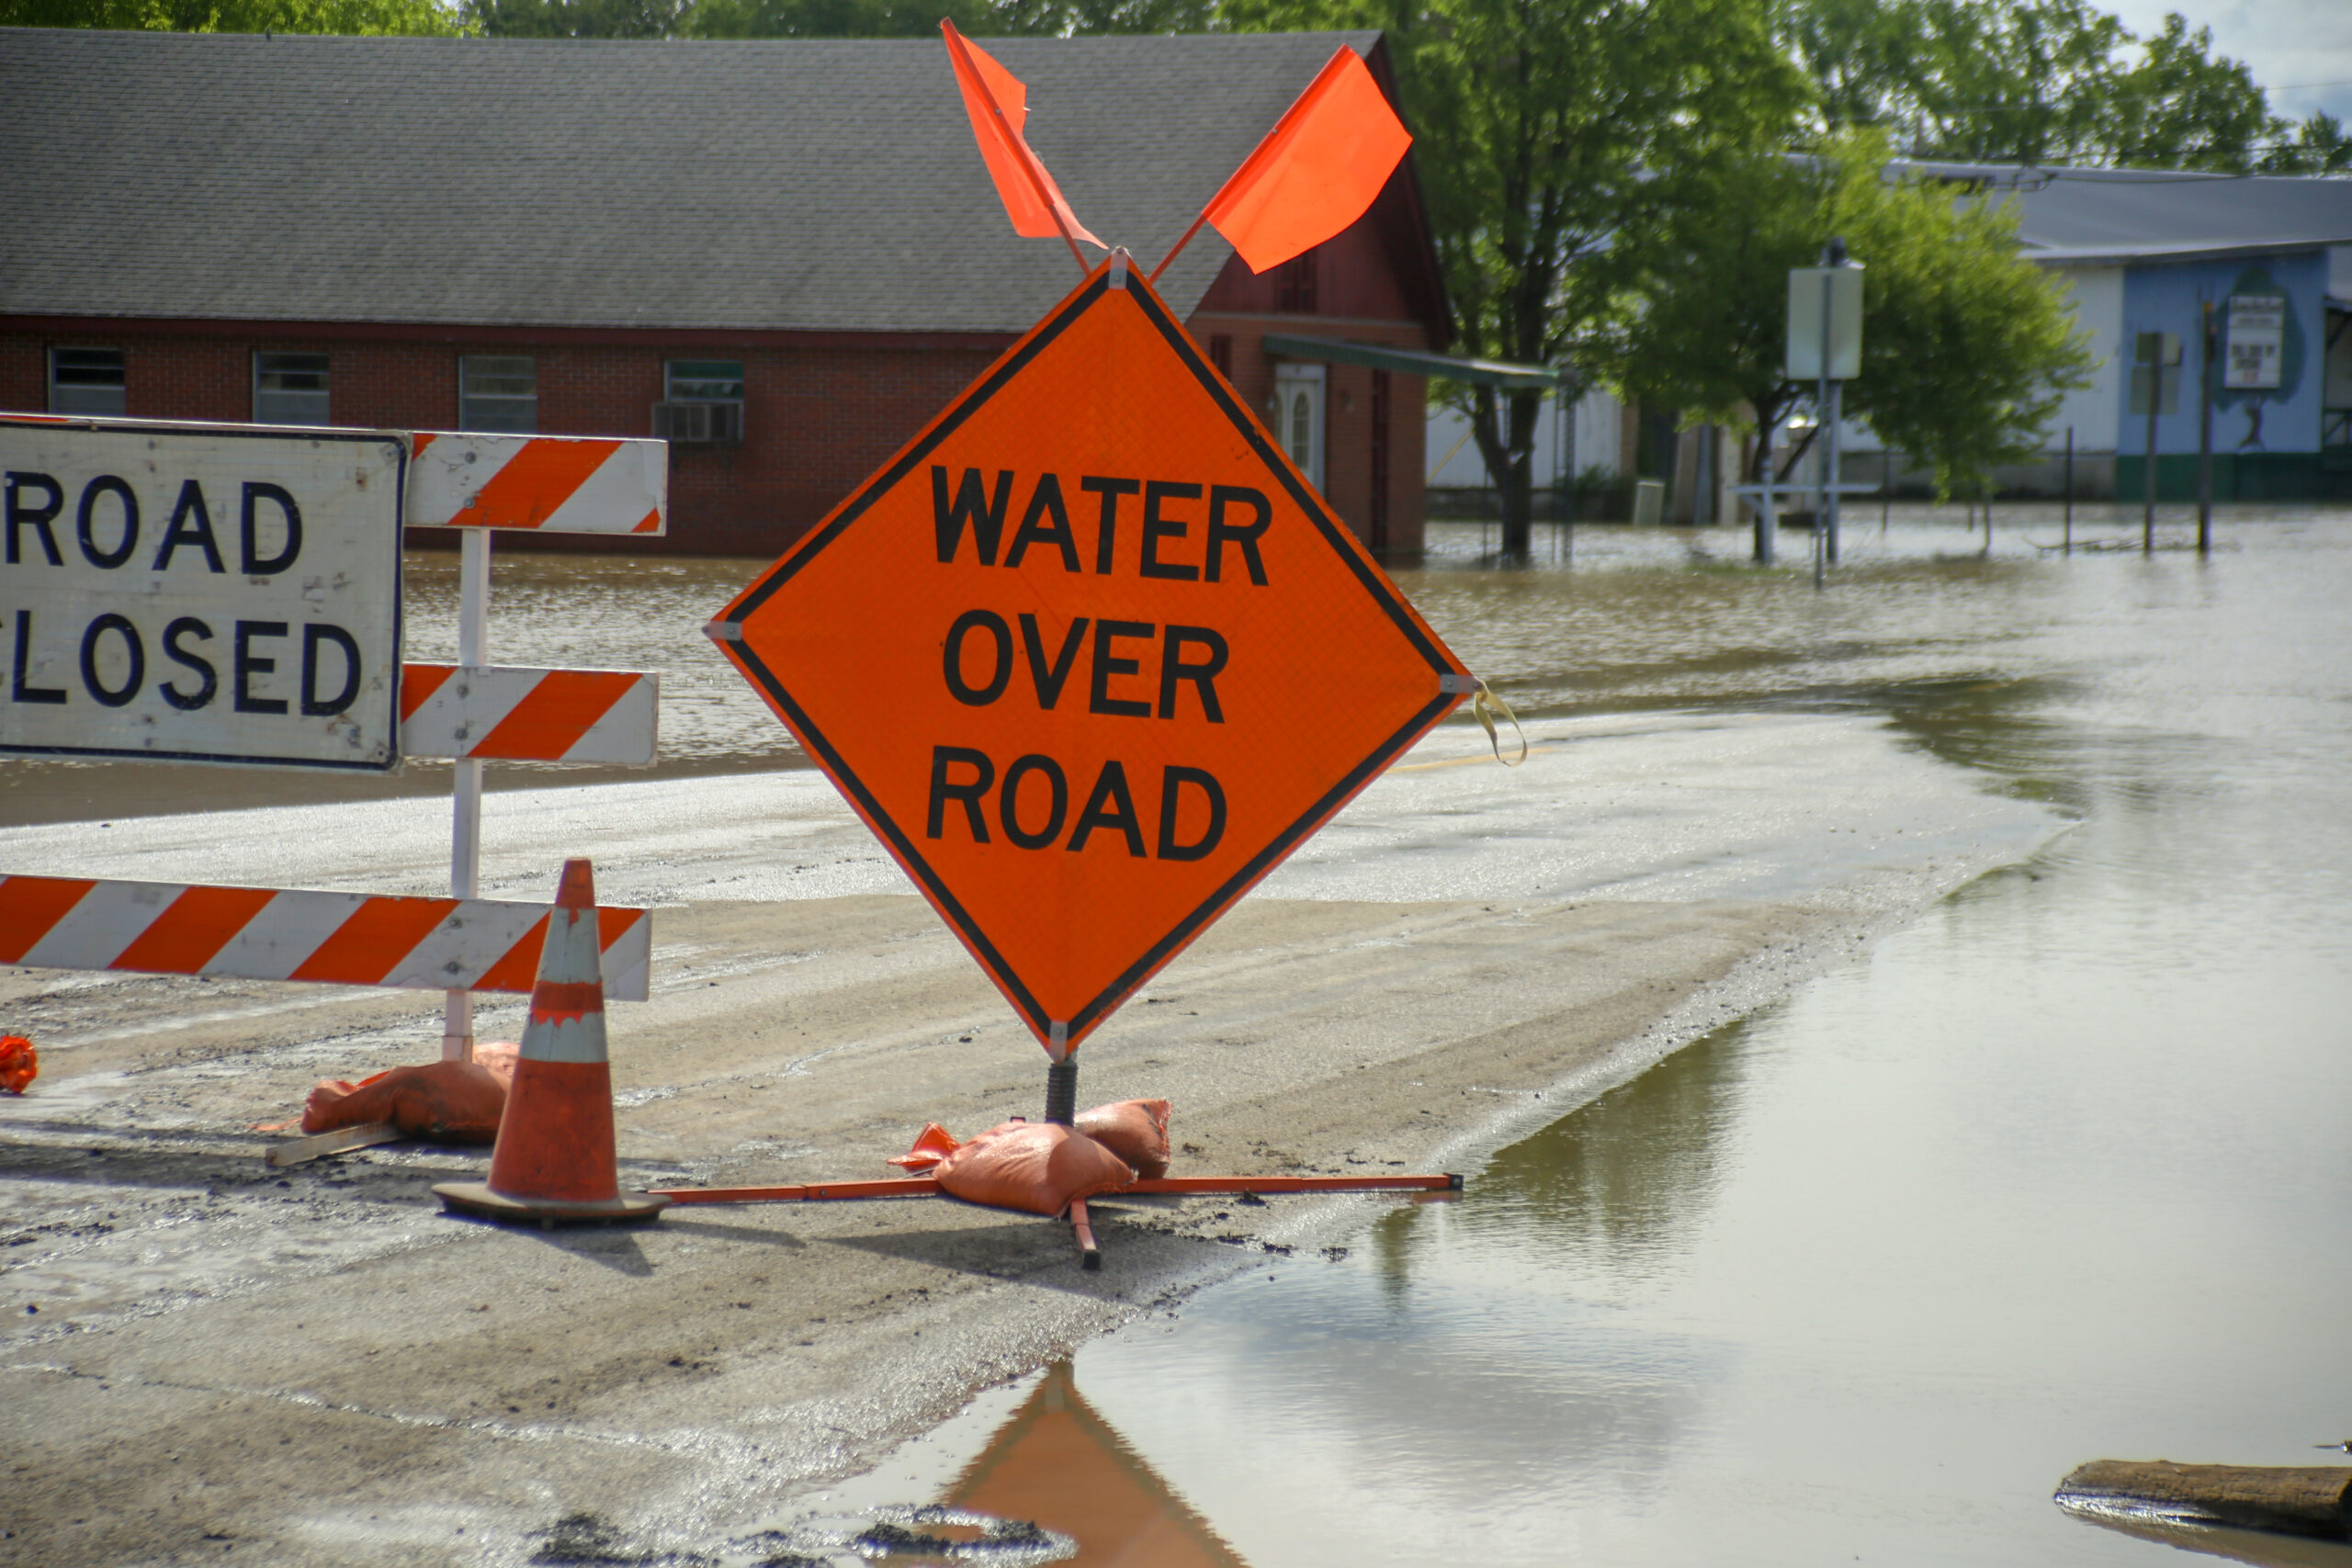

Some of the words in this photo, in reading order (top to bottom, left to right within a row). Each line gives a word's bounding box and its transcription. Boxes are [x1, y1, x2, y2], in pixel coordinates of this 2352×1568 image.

[4, 470, 304, 575] ROAD
[932, 466, 1272, 586] WATER
[0, 610, 363, 717] LOSED
[944, 610, 1229, 724] OVER
[927, 745, 1227, 862] ROAD
